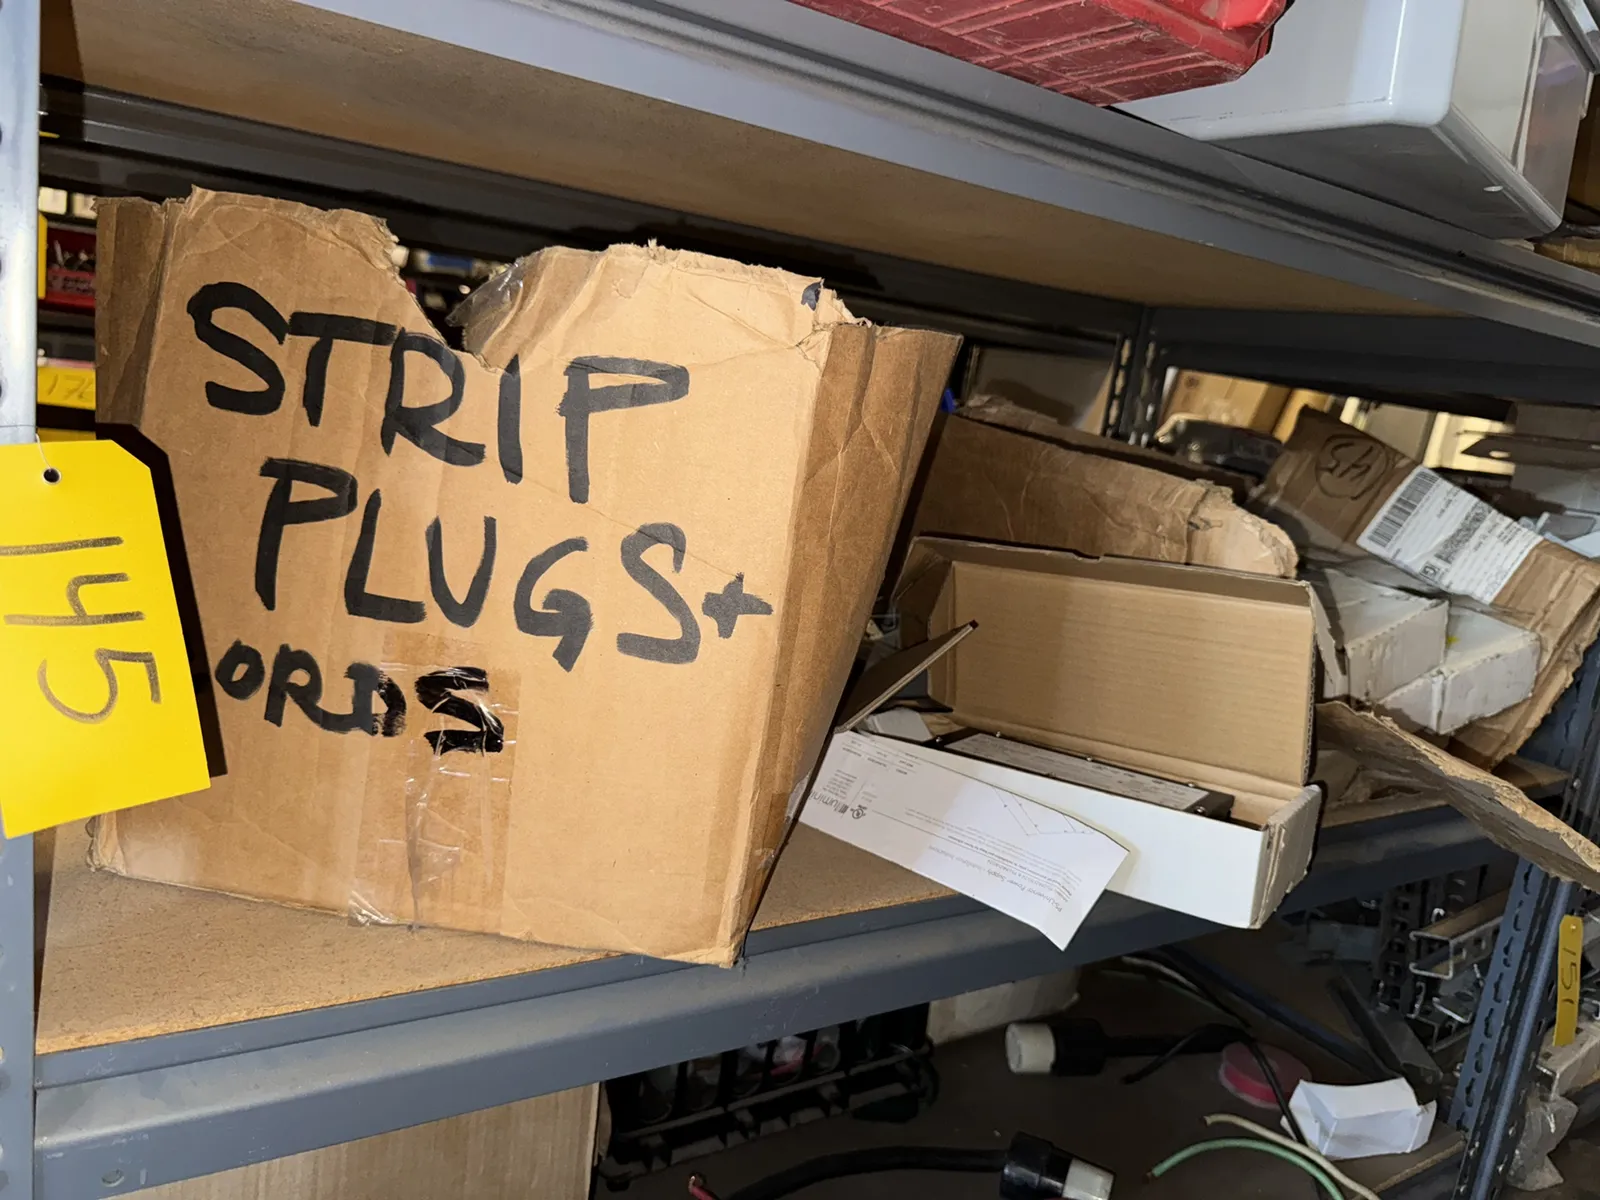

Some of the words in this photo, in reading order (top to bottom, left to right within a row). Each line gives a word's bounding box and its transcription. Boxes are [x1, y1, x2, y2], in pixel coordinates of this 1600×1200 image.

[187, 281, 689, 503] STRIP
[0, 536, 162, 724] 145
[212, 637, 505, 755] ORDS
